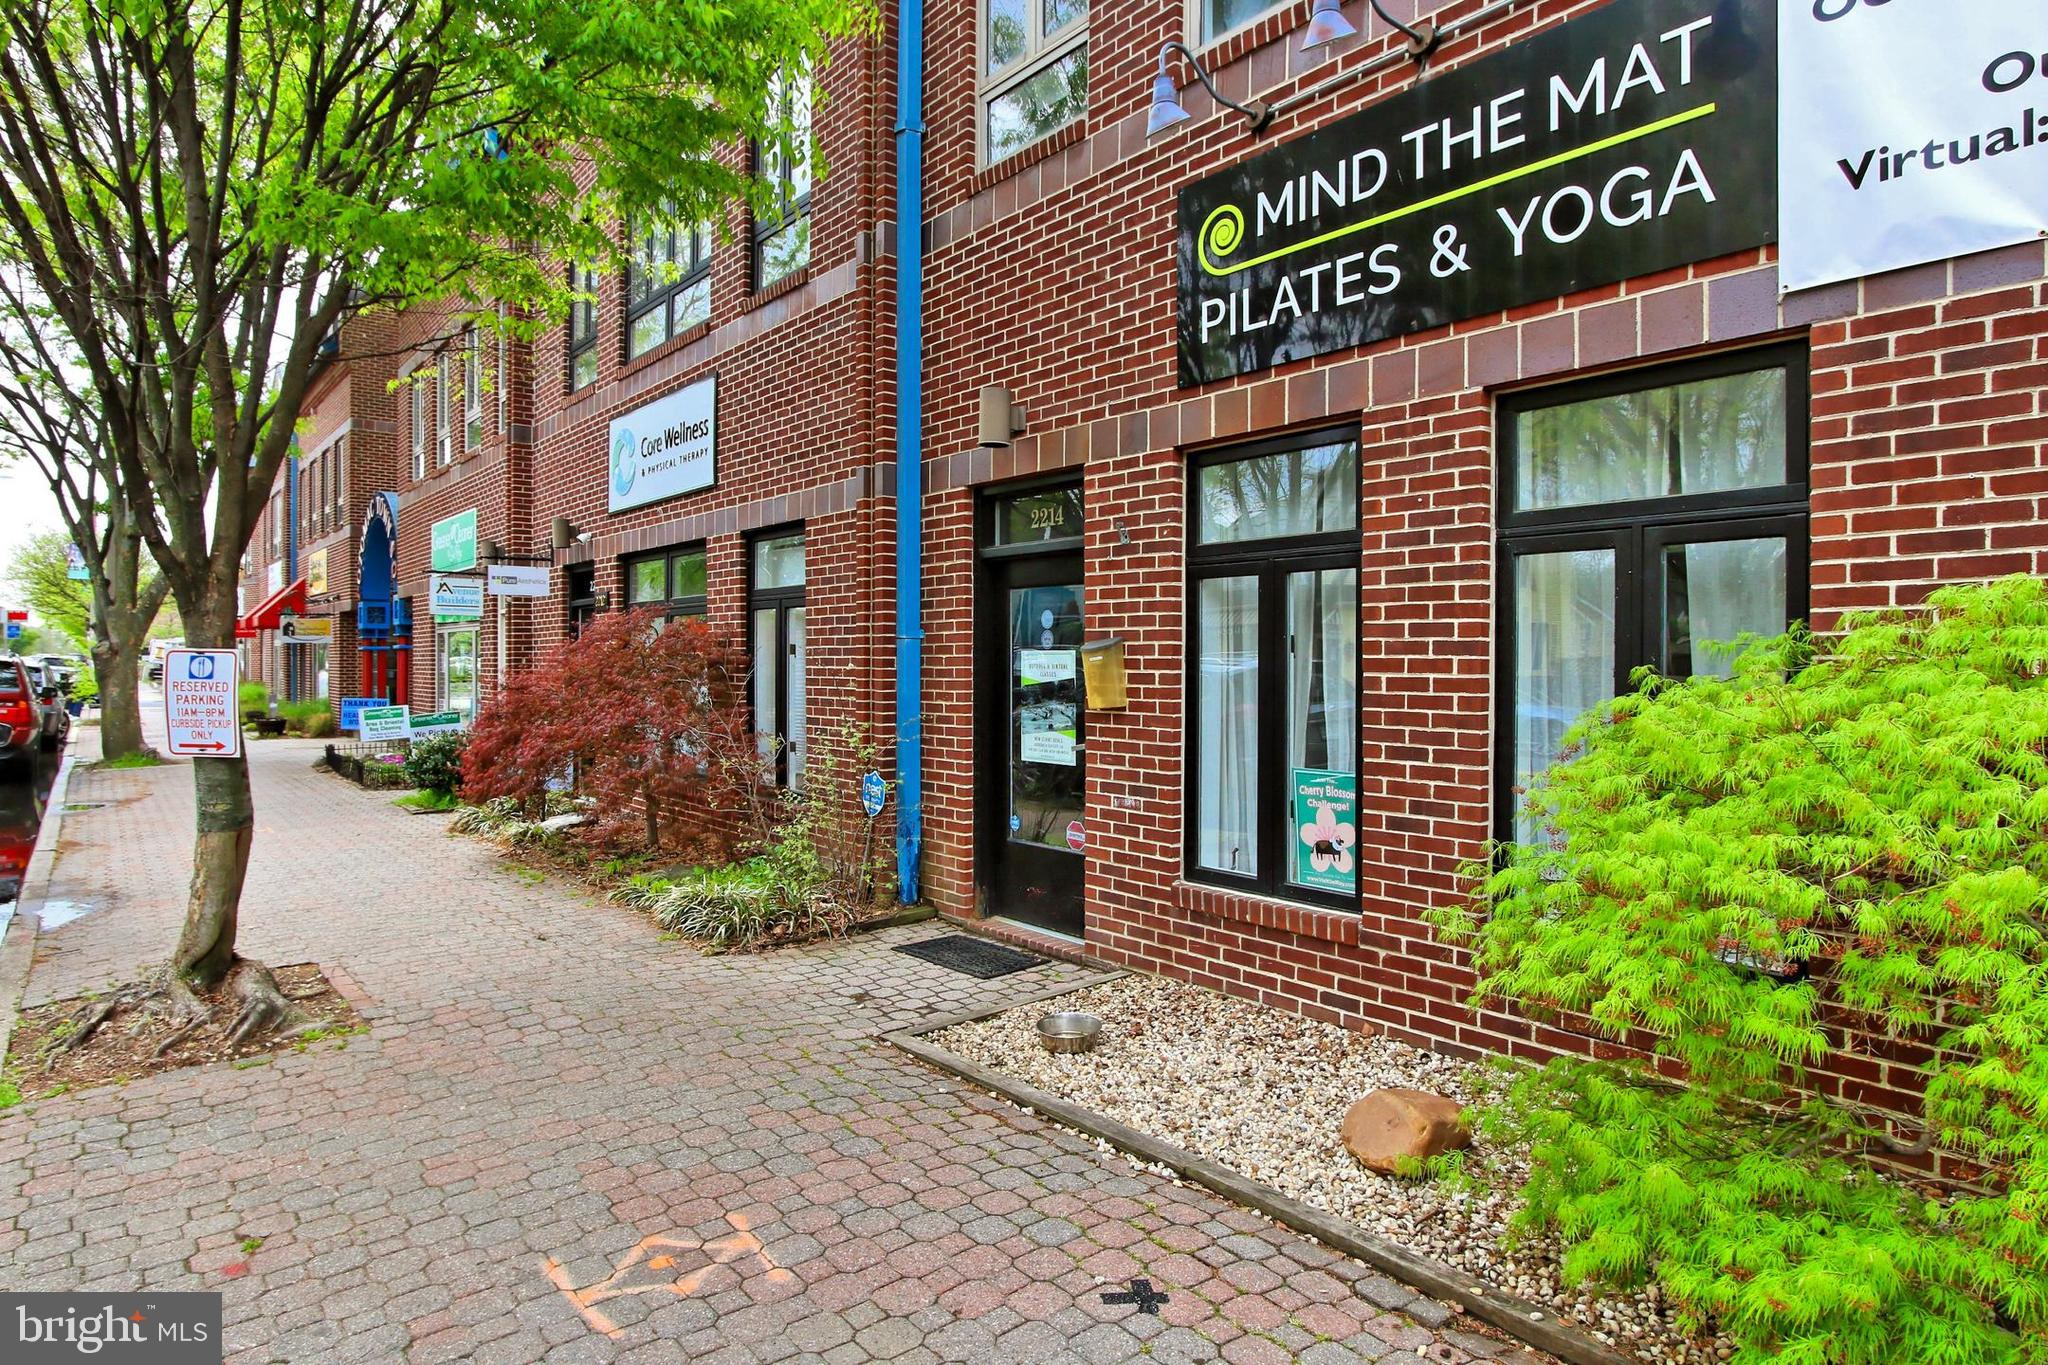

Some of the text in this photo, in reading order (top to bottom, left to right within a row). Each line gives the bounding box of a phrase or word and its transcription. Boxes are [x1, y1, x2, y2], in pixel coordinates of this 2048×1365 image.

[1981, 50, 2048, 93] O
[1255, 15, 1714, 238] MIND THE MAT
[1200, 147, 1717, 345] PILATES & YOGA
[640, 419, 709, 458] Core Wellness
[648, 458, 677, 475] PHYSICAL
[680, 447, 709, 465] THERAPY
[1031, 505, 1065, 529] 2214
[436, 582, 480, 595] Avenue
[436, 595, 480, 605] Builders
[172, 681, 229, 692] RESERVED
[176, 694, 224, 705] PARKING
[171, 719, 232, 728] CURBSIDE PICKUP
[191, 730, 213, 740] ONLY
[1299, 785, 1324, 797] Cherry
[1307, 798, 1350, 811] Challenge!
